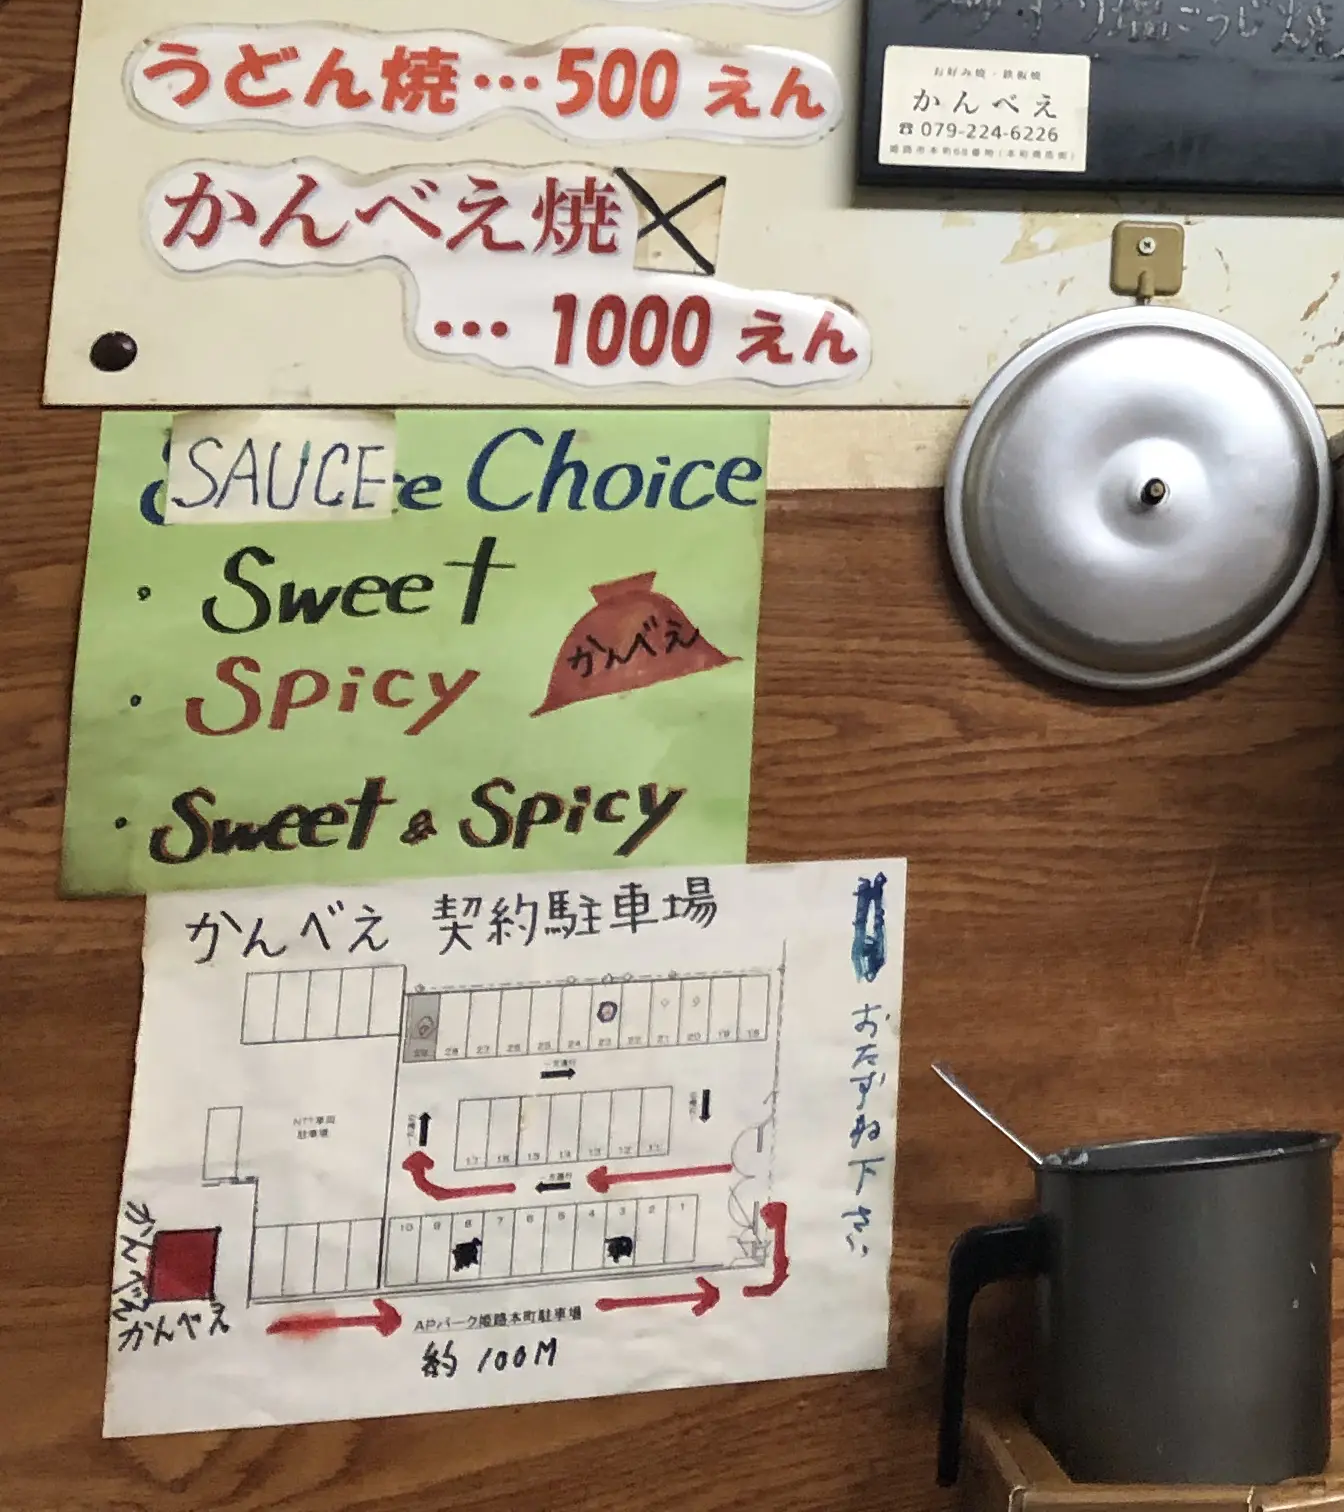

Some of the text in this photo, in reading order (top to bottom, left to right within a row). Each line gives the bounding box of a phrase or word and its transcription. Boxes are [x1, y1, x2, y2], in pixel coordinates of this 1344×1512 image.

[913, 88, 1057, 119] かんべえ
[921, 121, 1059, 143] 079-224-6226
[162, 170, 621, 258] かんべえ焼
[172, 437, 391, 512] SAUCE
[467, 426, 763, 513] Choice
[202, 535, 516, 634] Sweet
[567, 619, 700, 680] かんべえ
[185, 656, 481, 736] Spicy
[149, 775, 396, 864] Sweet
[458, 776, 688, 857] Spicy
[186, 878, 718, 964] かんべえ 契約駐車場
[117, 1302, 230, 1351] かんべえ
